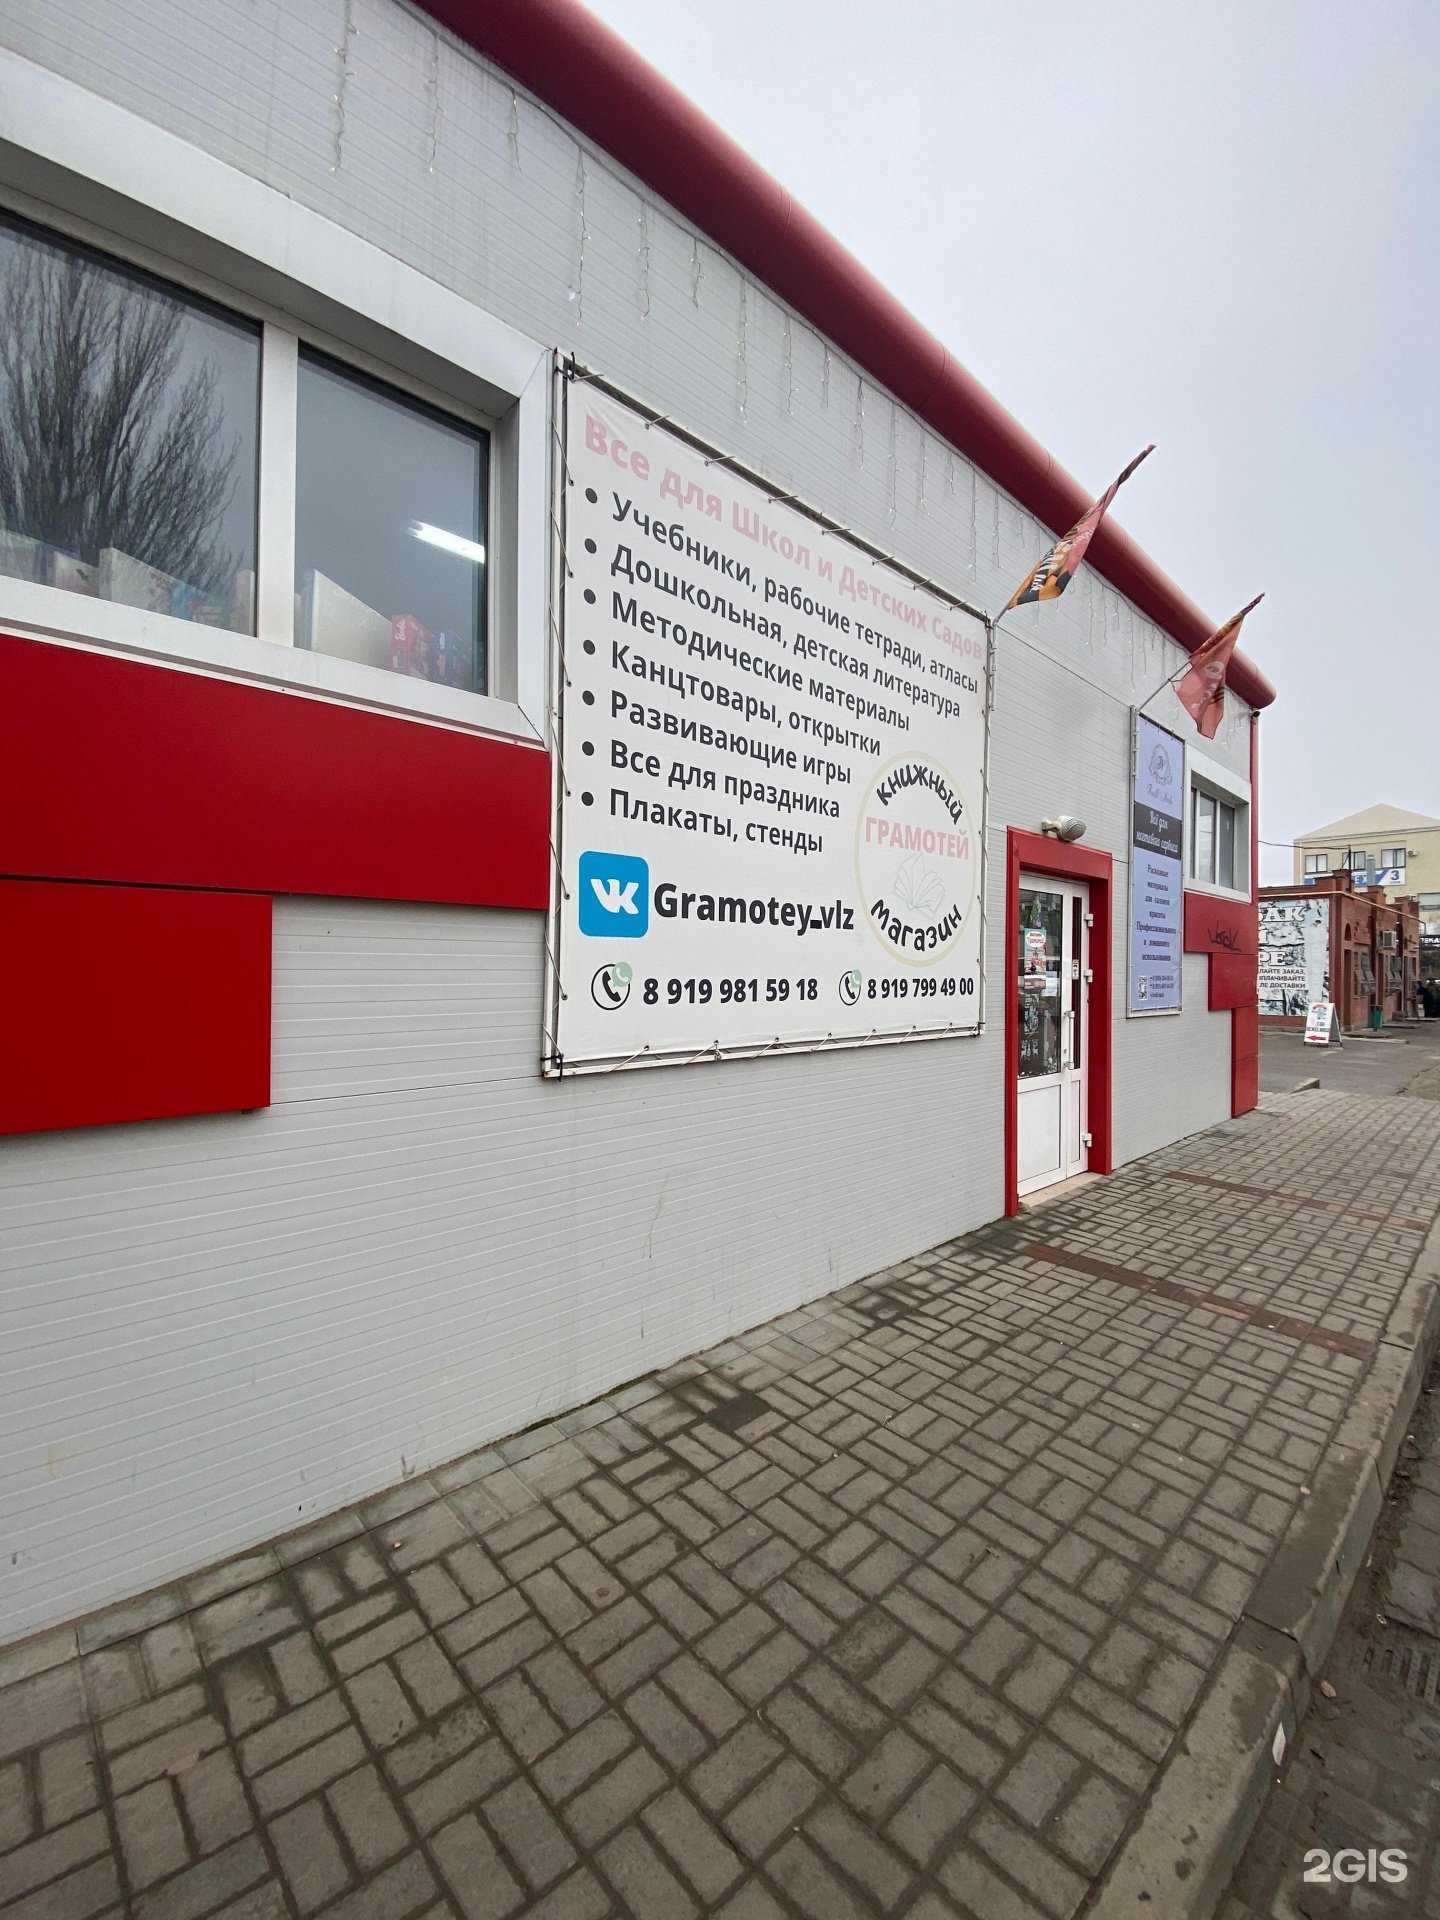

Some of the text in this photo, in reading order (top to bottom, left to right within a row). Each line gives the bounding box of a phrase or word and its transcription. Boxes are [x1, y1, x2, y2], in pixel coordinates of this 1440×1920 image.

[585, 414, 983, 661] Все для Школ и Детских Садов
[611, 544, 960, 718] Дошкольная, детская литература
[612, 490, 978, 694] Учебники, рабочие тетради, атласы
[612, 640, 881, 756] Канцтовары, открытки
[613, 591, 909, 731] Методические материалы
[610, 739, 840, 818] Все для праздника
[611, 689, 851, 785] Развивающие игры
[610, 788, 823, 855] Плакаты, стенды
[865, 816, 969, 860] ГРАМОТЕЙ
[653, 882, 854, 936] Gramotey_vlz
[643, 978, 818, 1005] 8 919 981 59 18
[867, 977, 974, 999] 8 919 799 49 00
